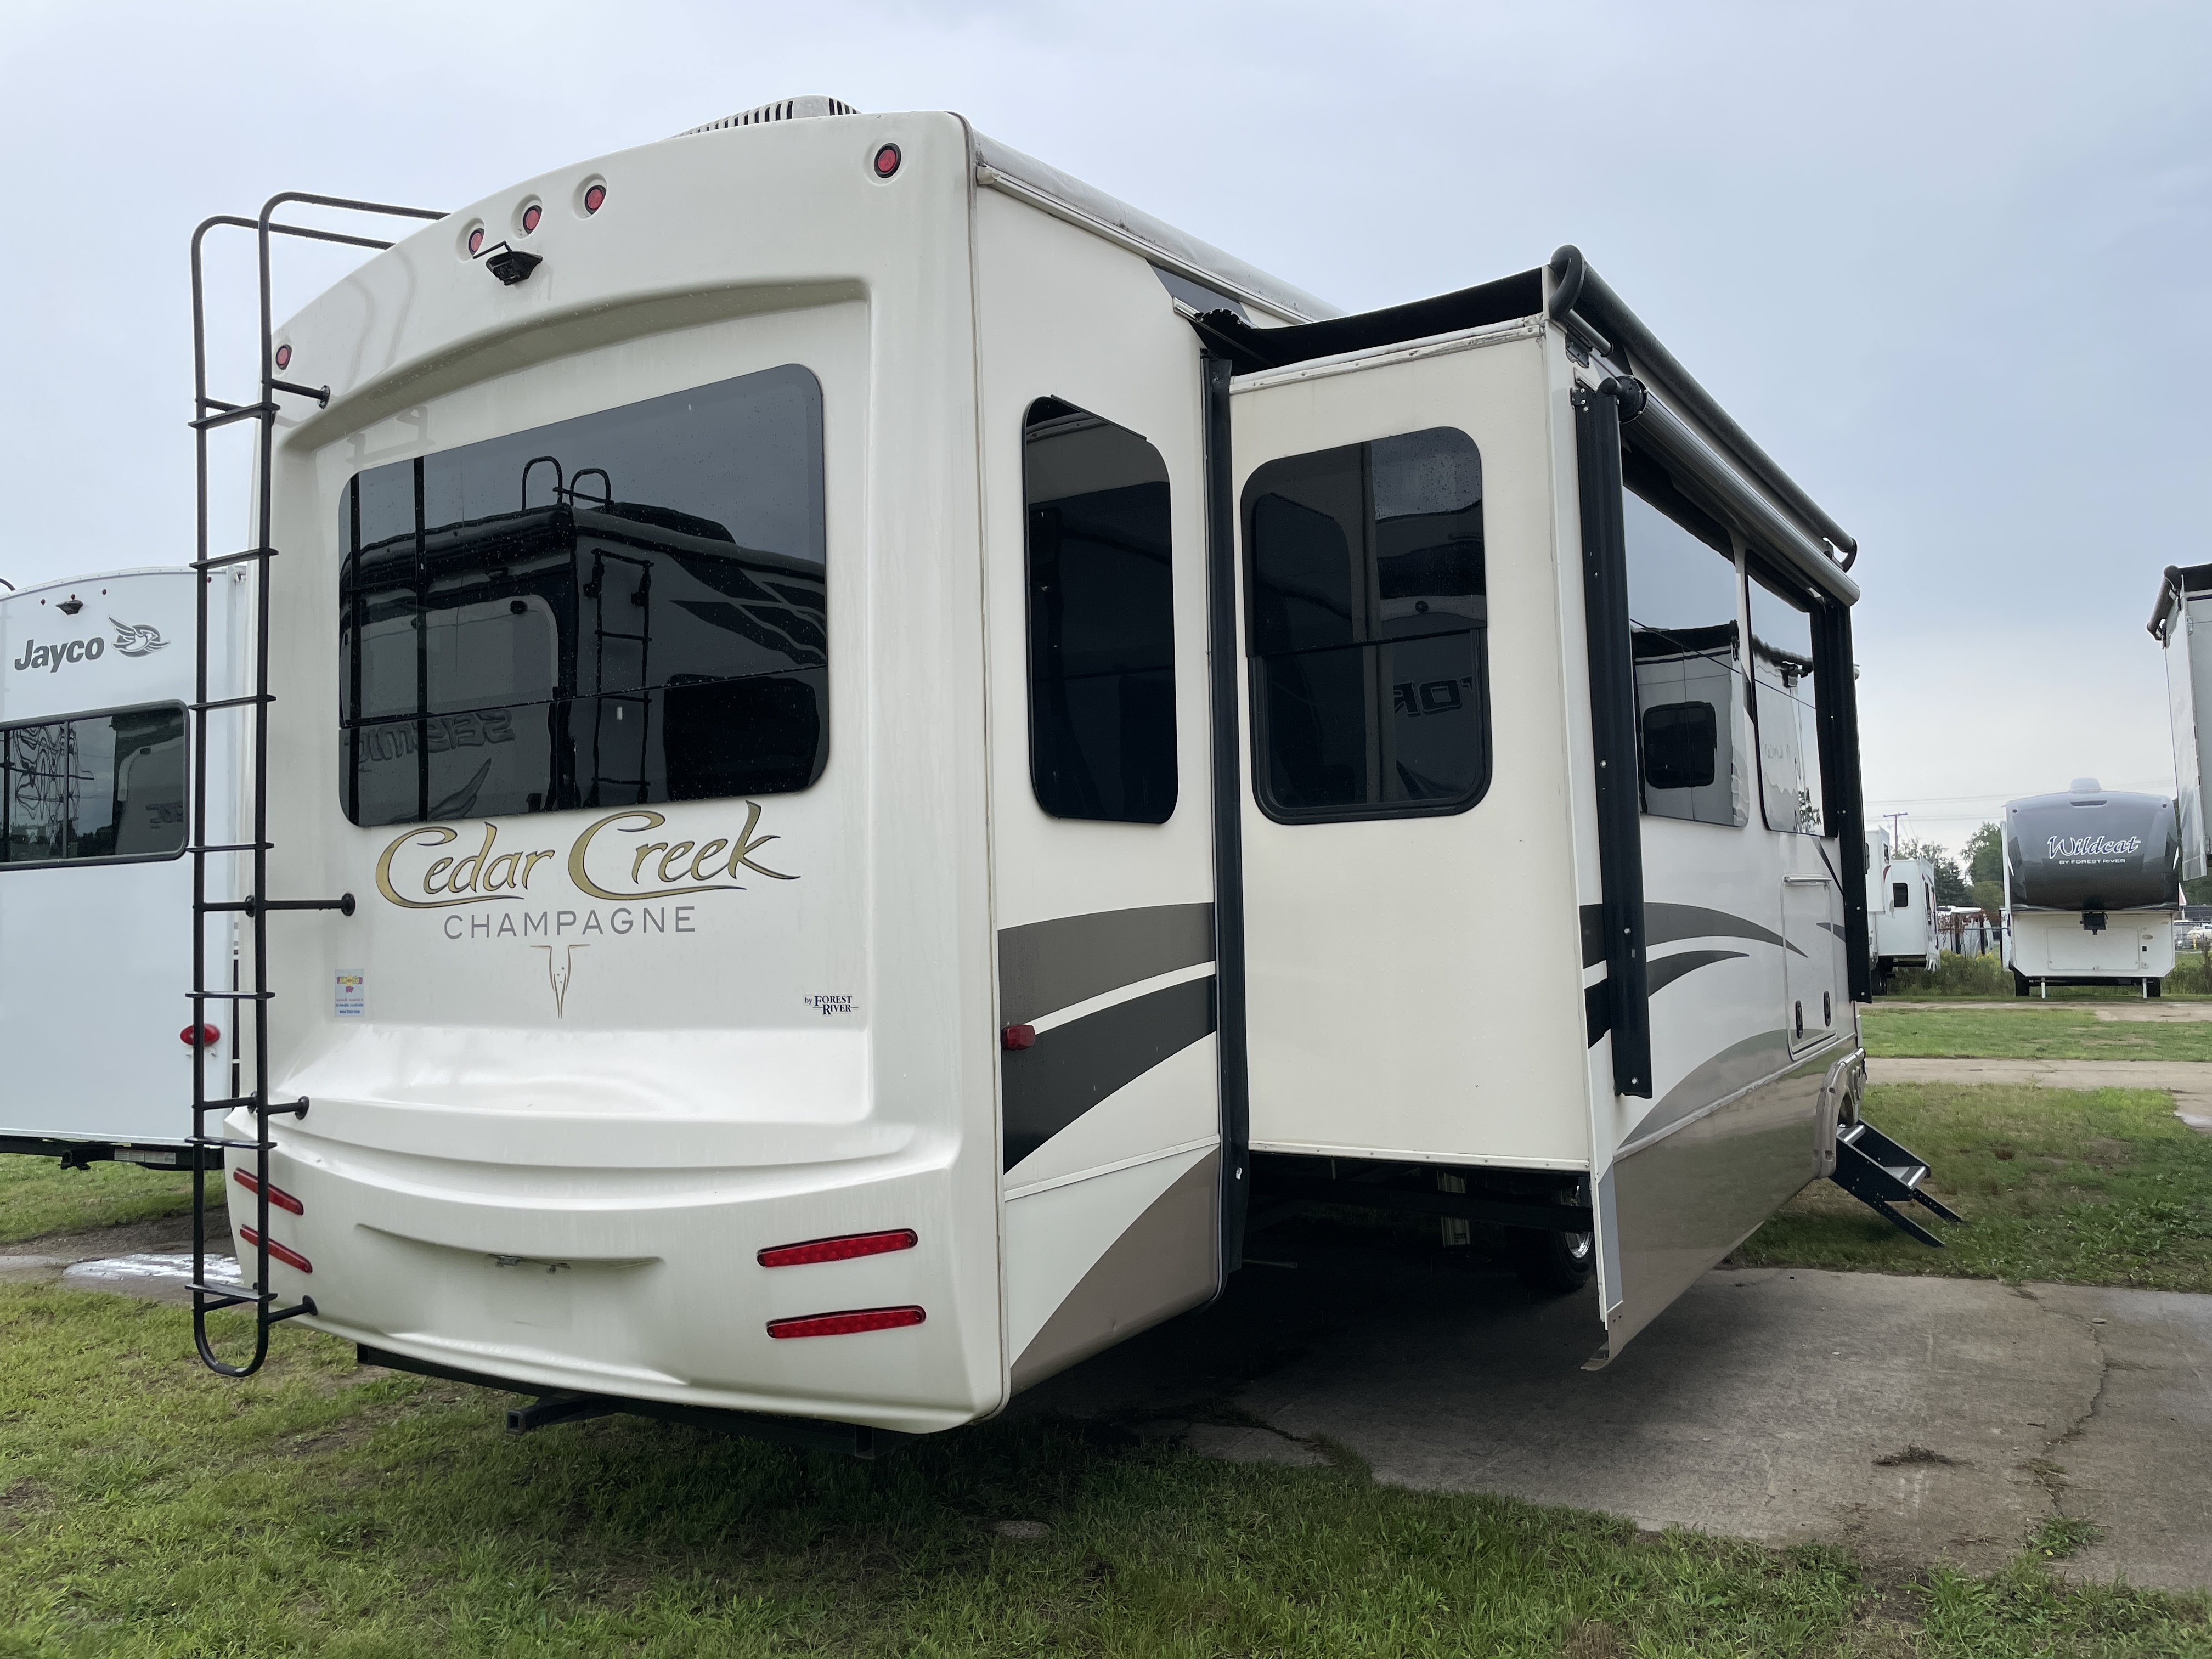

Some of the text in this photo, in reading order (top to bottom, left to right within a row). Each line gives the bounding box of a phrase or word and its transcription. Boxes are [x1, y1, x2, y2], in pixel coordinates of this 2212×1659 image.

[14, 637, 105, 674] Jayco
[375, 800, 802, 909] Cedar Creek
[2047, 836, 2141, 860] Wildcat
[444, 906, 696, 940] CHAMPAGNE
[804, 995, 853, 1007] by FOREST
[822, 1004, 851, 1015] RIVER
